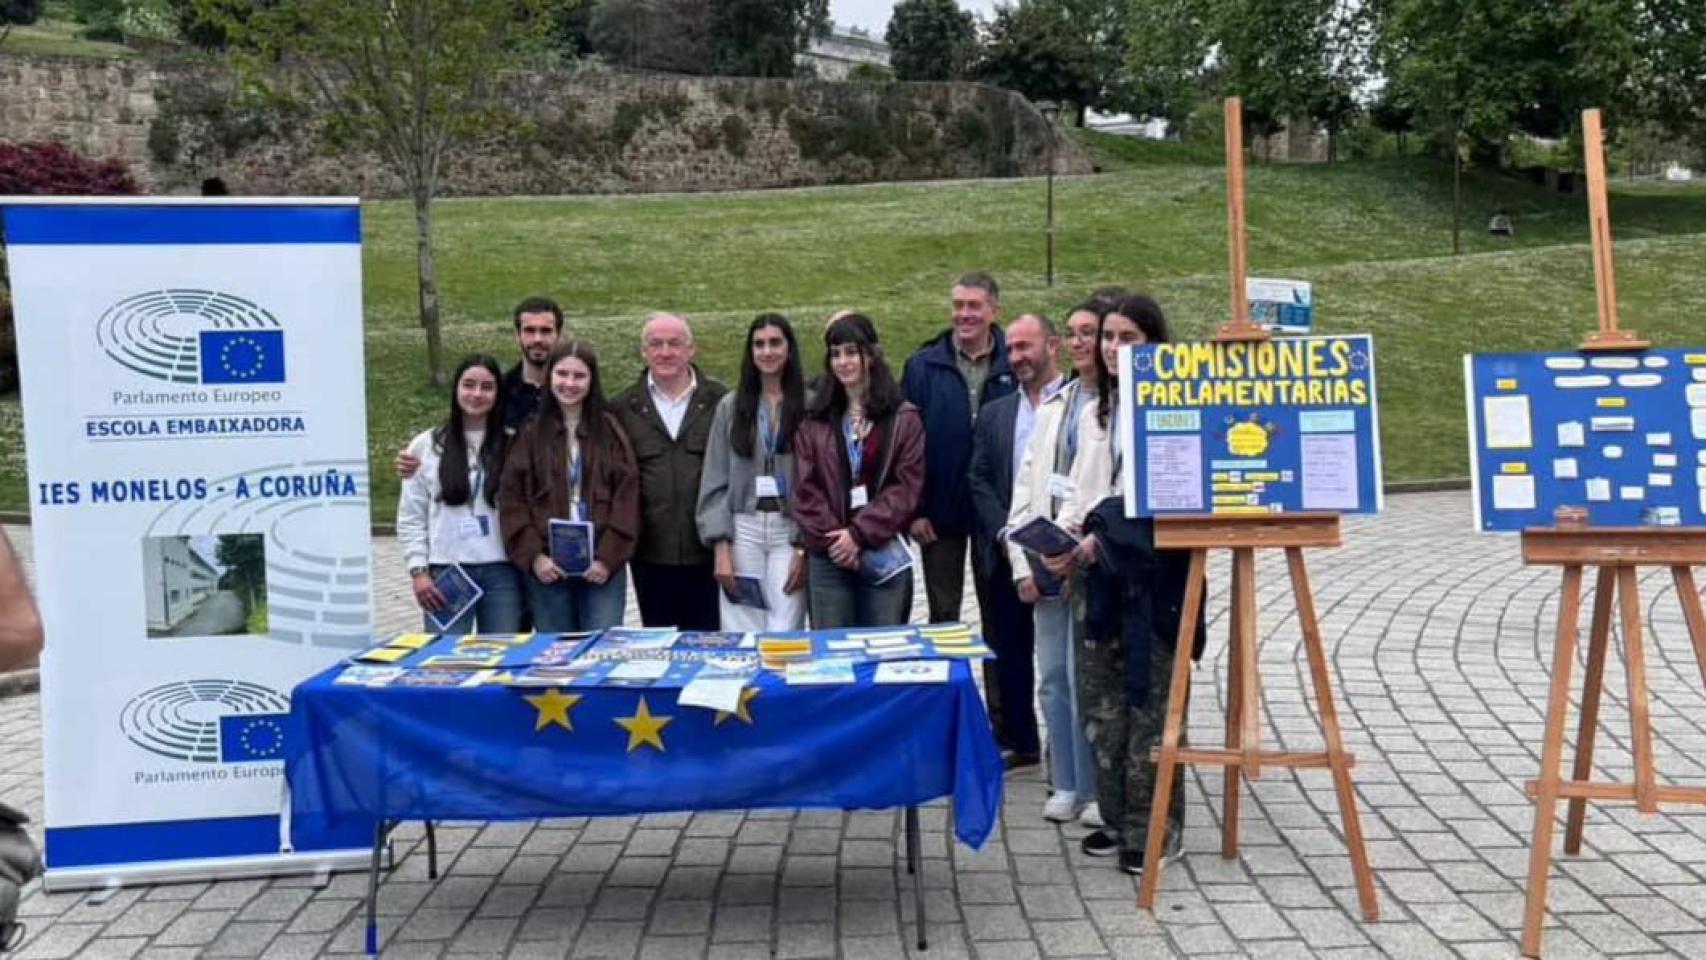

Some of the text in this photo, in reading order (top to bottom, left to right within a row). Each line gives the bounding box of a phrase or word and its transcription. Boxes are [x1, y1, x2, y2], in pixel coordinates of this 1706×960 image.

[1155, 340, 1350, 378] COMISIONES
[113, 388, 282, 405] Parlamento Europeo
[1137, 379, 1367, 406] PARLAMENTARIAS
[87, 417, 305, 436] ESCOLA EMBAIXADORA
[40, 483, 79, 504] IES
[91, 479, 207, 503] MONELOS
[236, 477, 250, 499] A
[259, 469, 357, 498] CORUÑA
[135, 770, 228, 784] Parlamento
